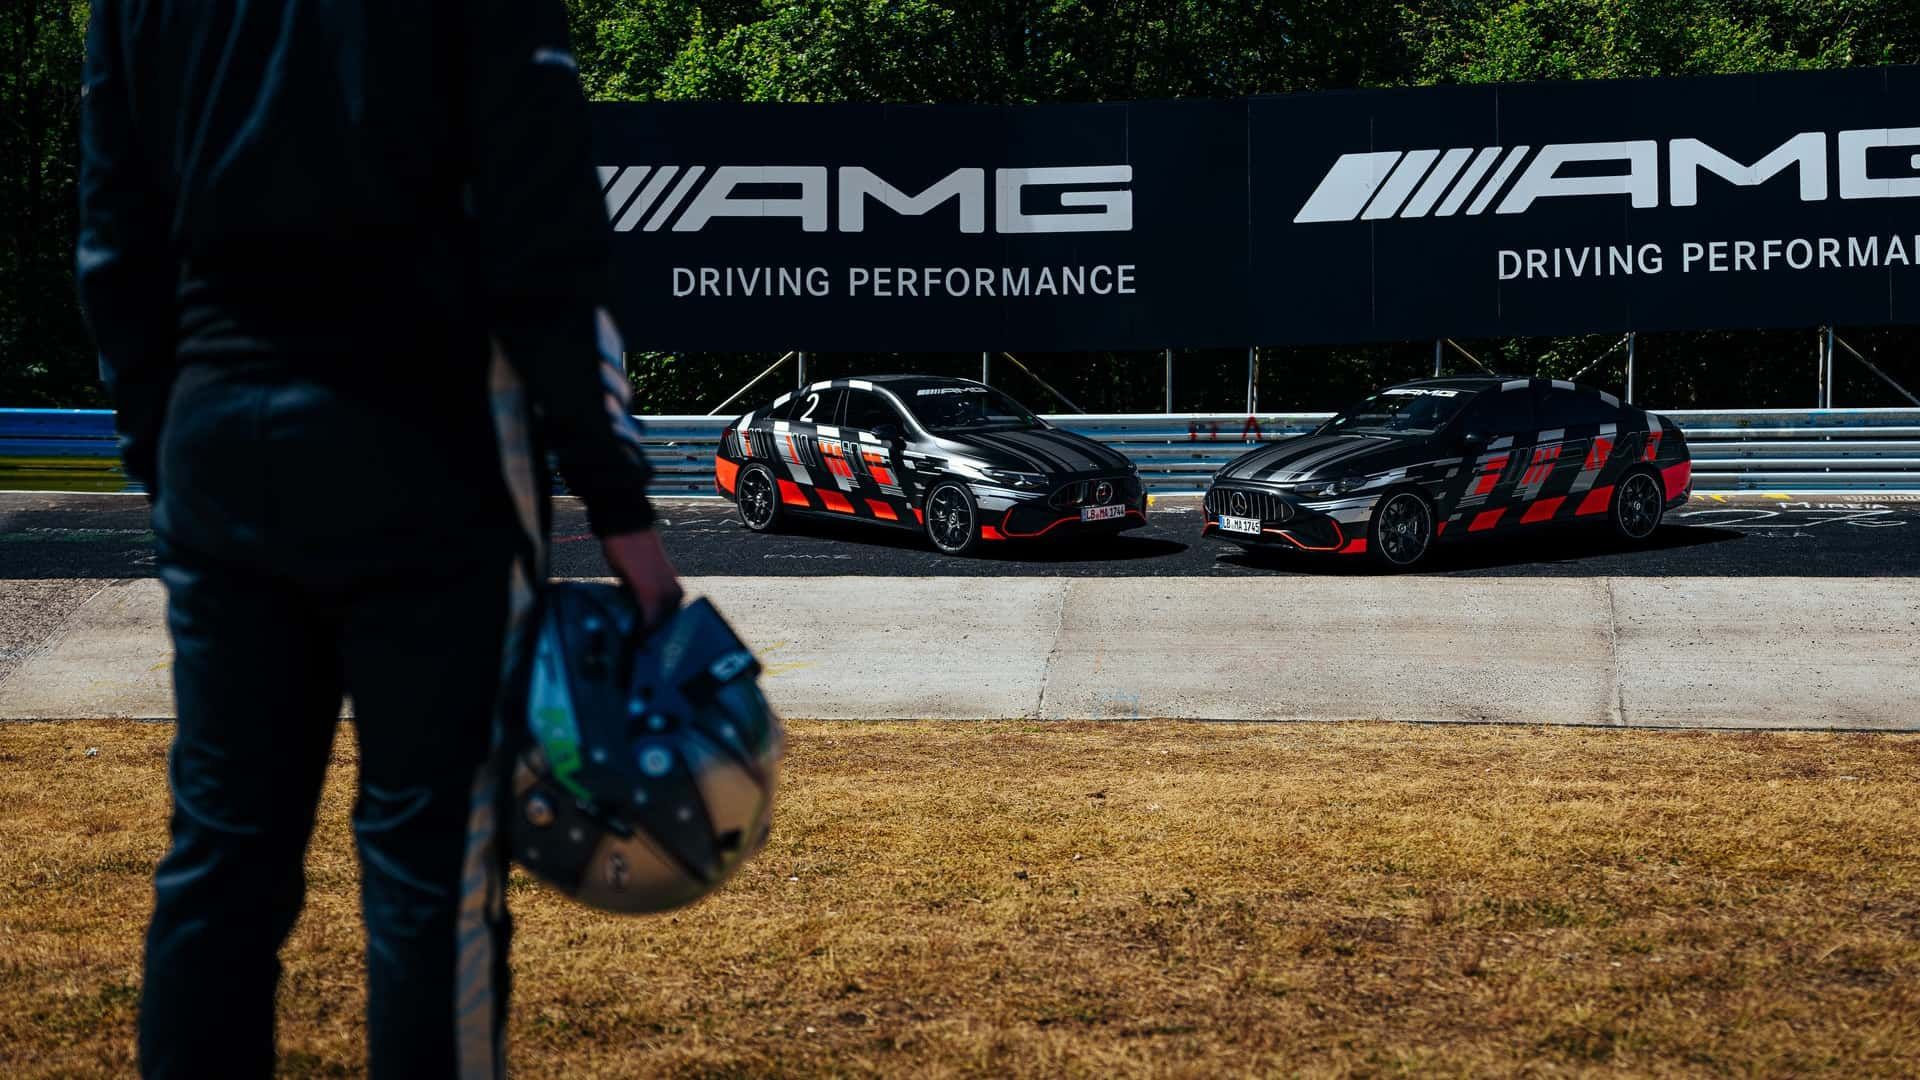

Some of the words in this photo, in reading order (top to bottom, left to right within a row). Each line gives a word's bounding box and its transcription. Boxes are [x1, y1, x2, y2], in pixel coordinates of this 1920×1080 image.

[1495, 126, 1920, 214] AMG
[671, 165, 1133, 233] AMG
[1498, 243, 1663, 280] DRIVING
[672, 267, 830, 297] DRIVING
[849, 264, 1136, 297] PERFORMANCE
[800, 393, 820, 423] 2
